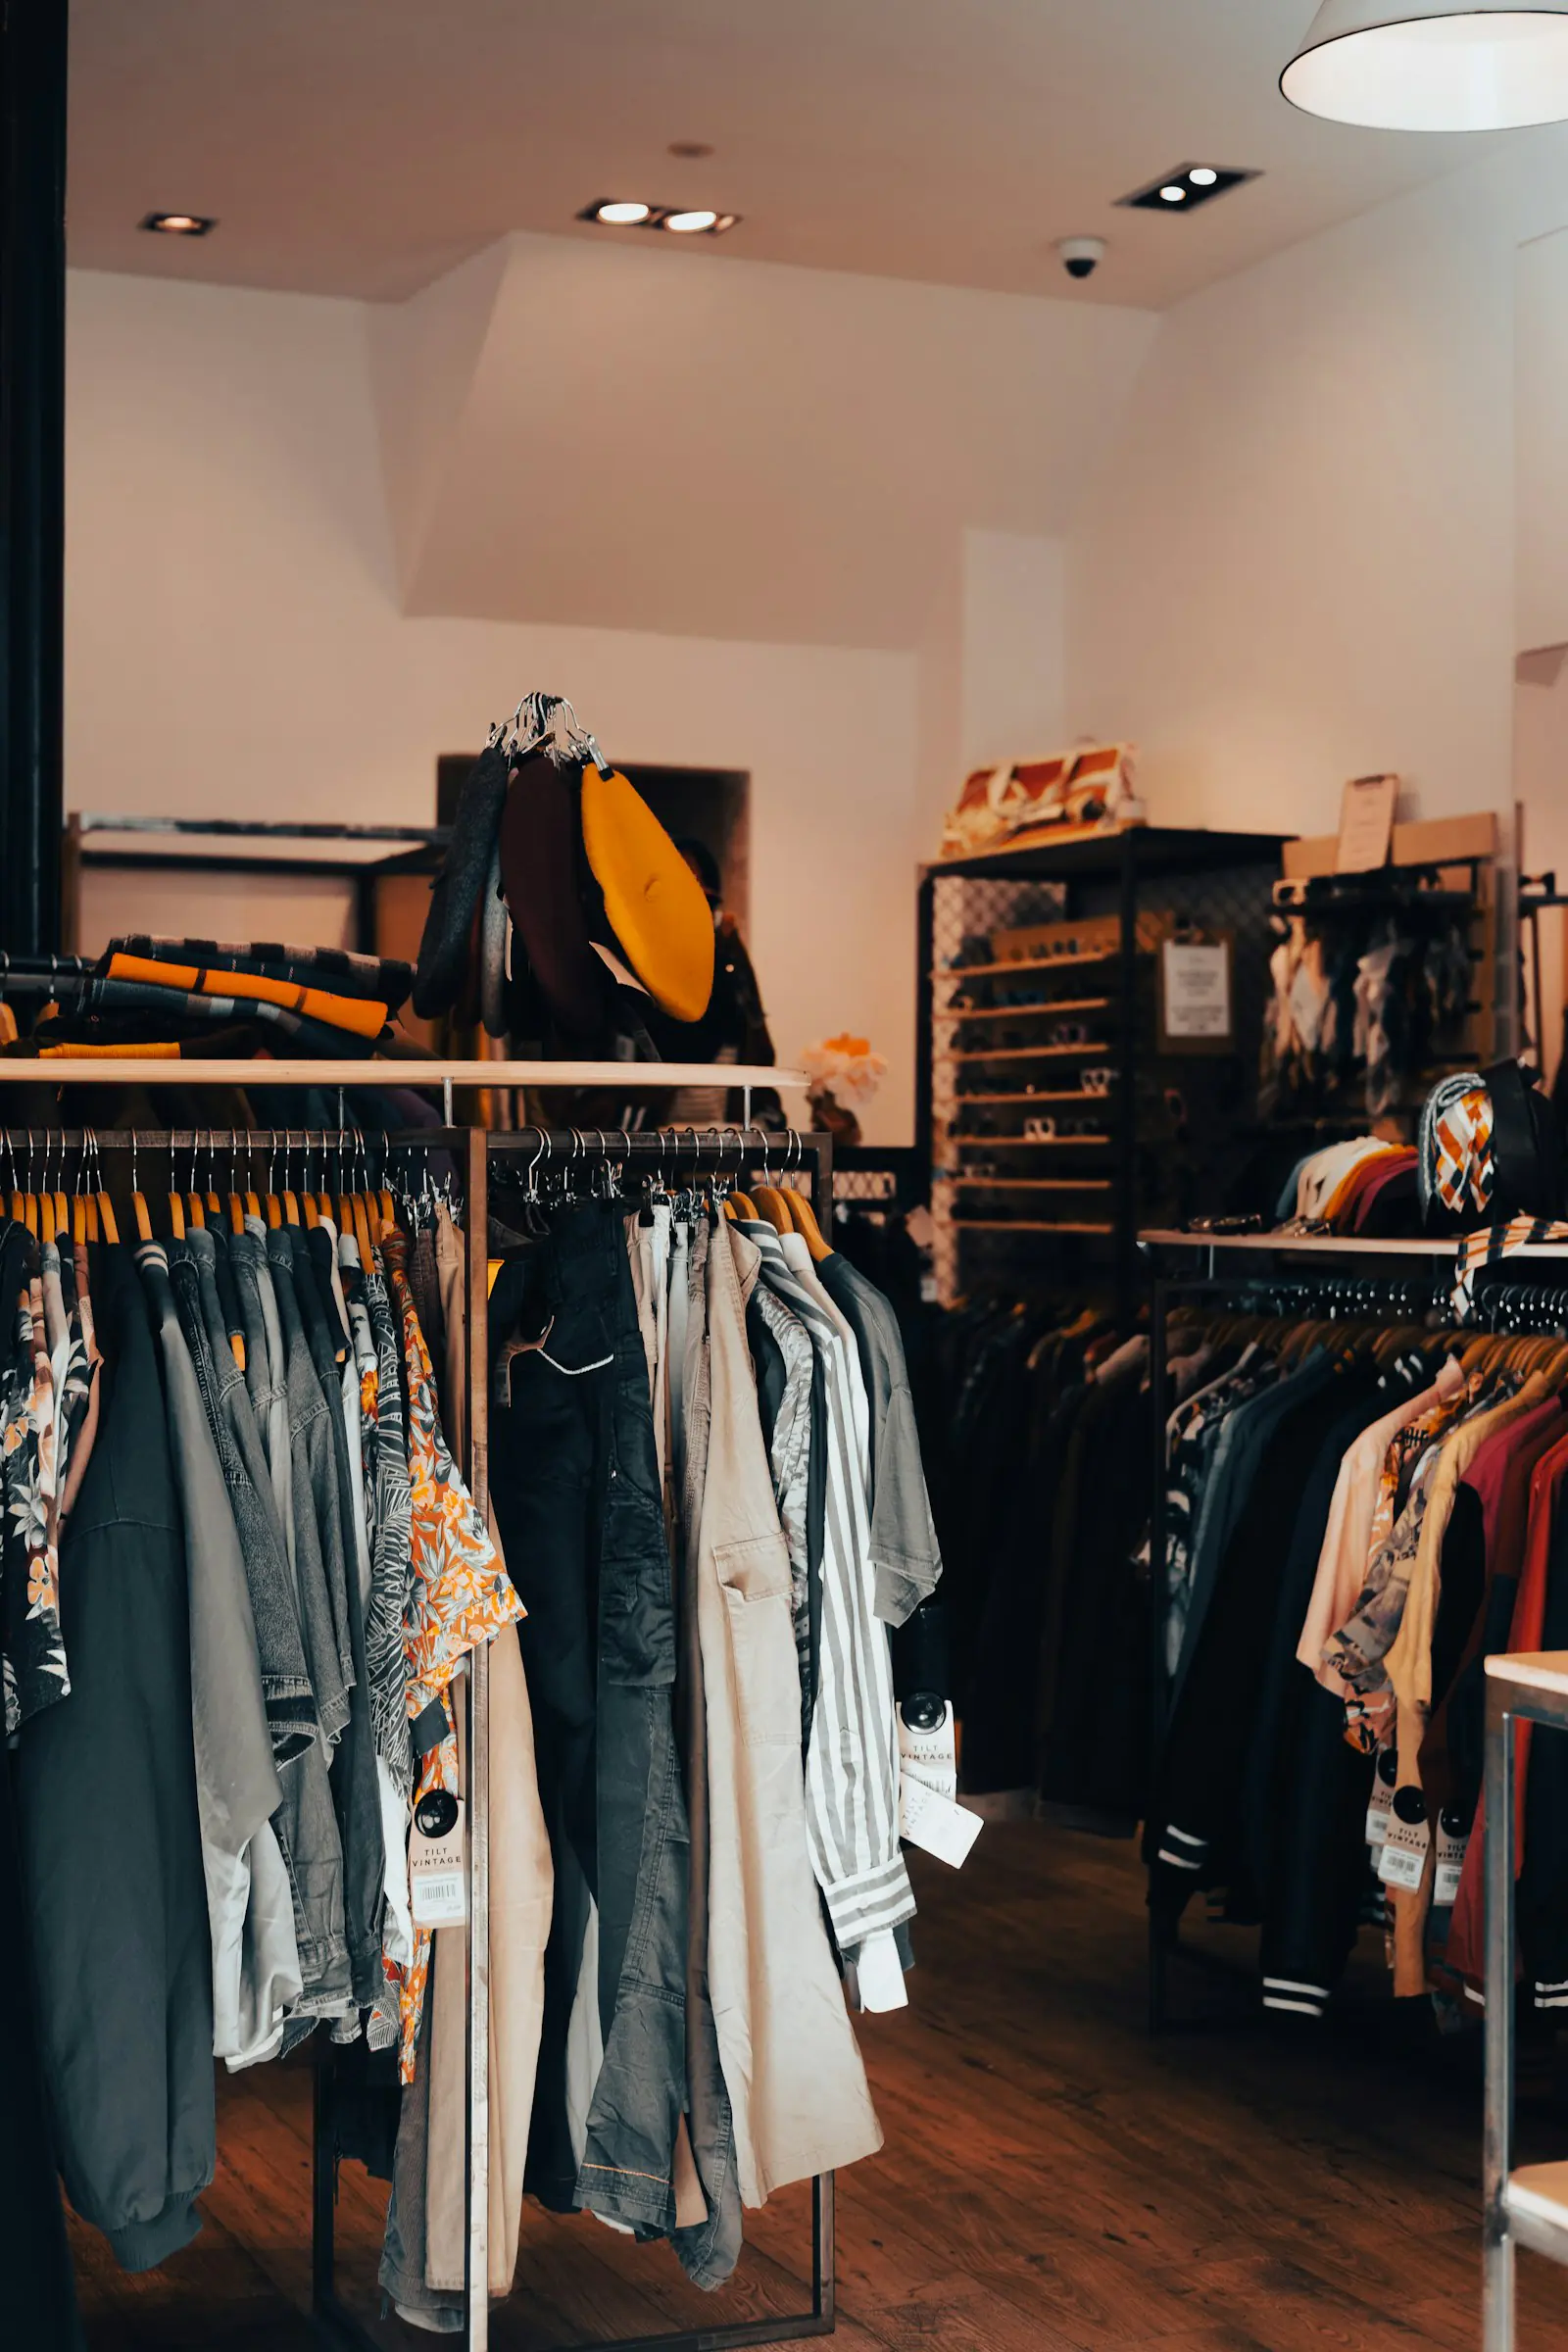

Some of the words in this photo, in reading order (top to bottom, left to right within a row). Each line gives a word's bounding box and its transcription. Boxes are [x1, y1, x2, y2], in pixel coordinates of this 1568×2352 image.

[1399, 1828, 1419, 1838] TILT
[1388, 1833, 1427, 1849] VINTAGE
[424, 1847, 448, 1856] TILT
[412, 1855, 462, 1867] VINTAGE
